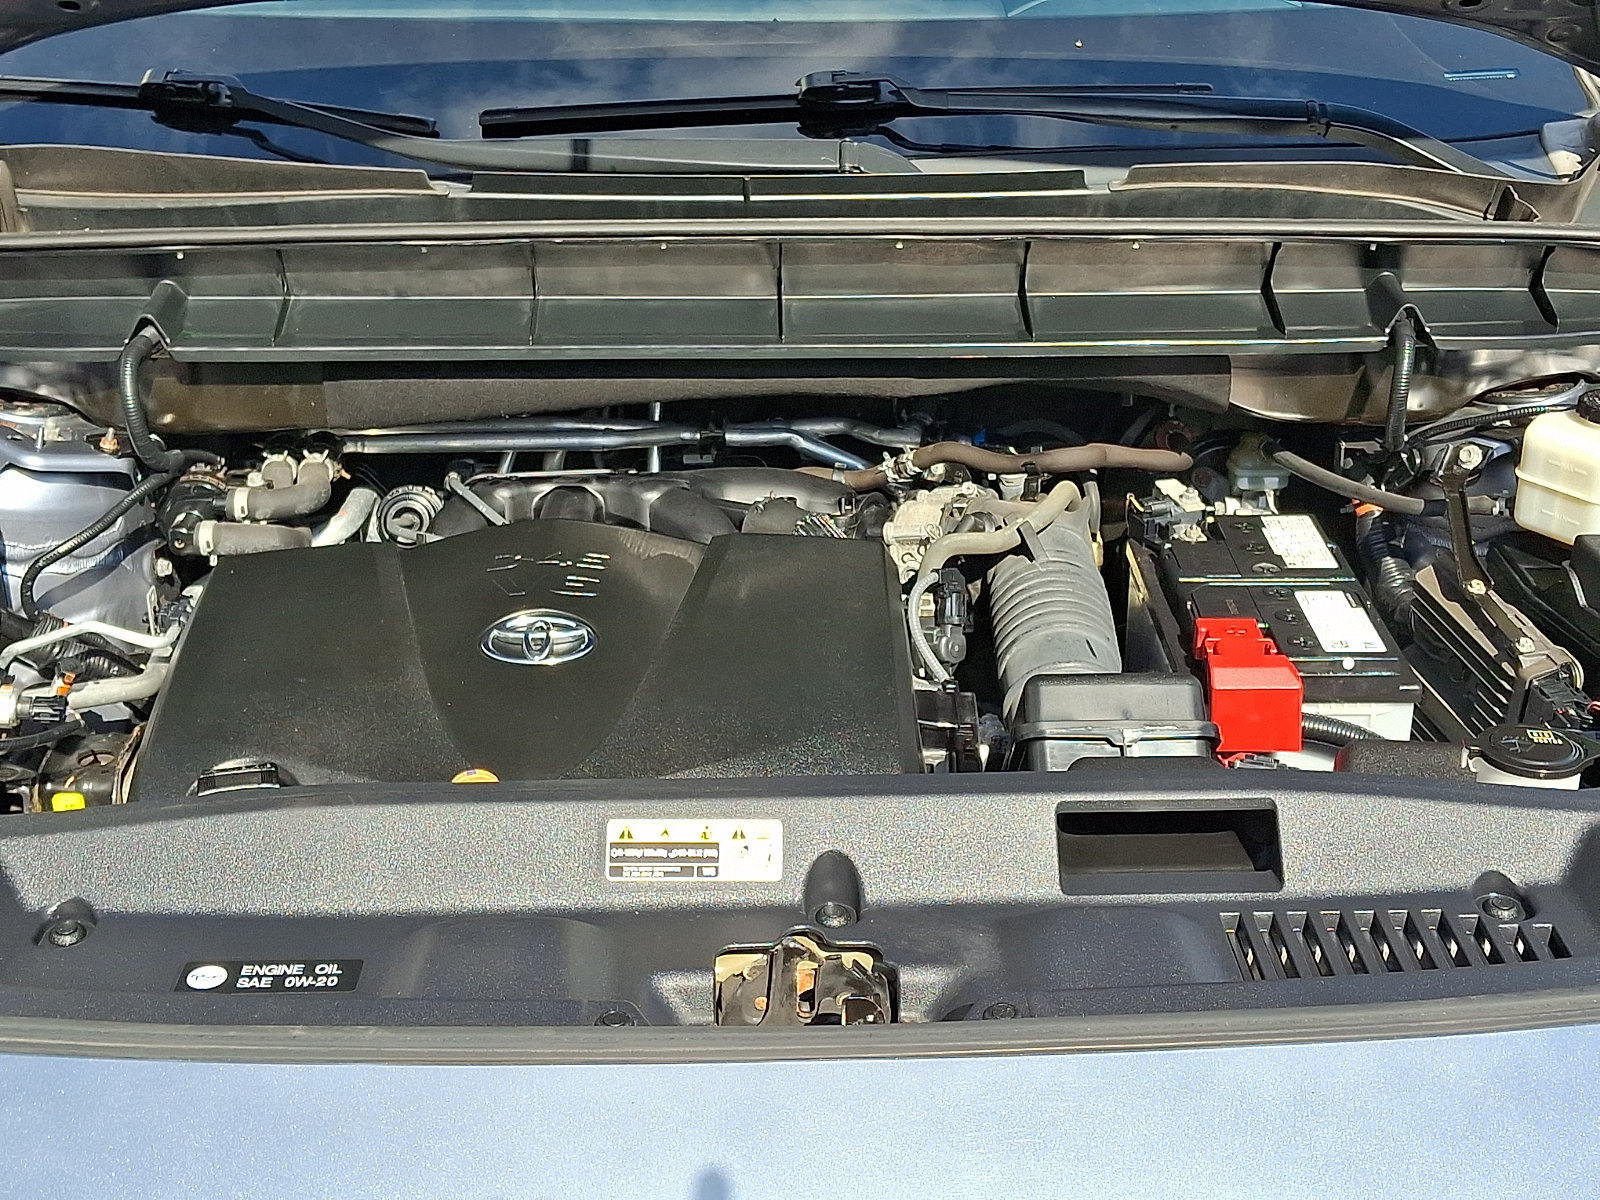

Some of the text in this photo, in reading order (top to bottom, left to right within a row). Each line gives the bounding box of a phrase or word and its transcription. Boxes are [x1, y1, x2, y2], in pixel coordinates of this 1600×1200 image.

[241, 963, 343, 976] ENGINE OIL
[236, 976, 338, 988] SAE 0W-20
